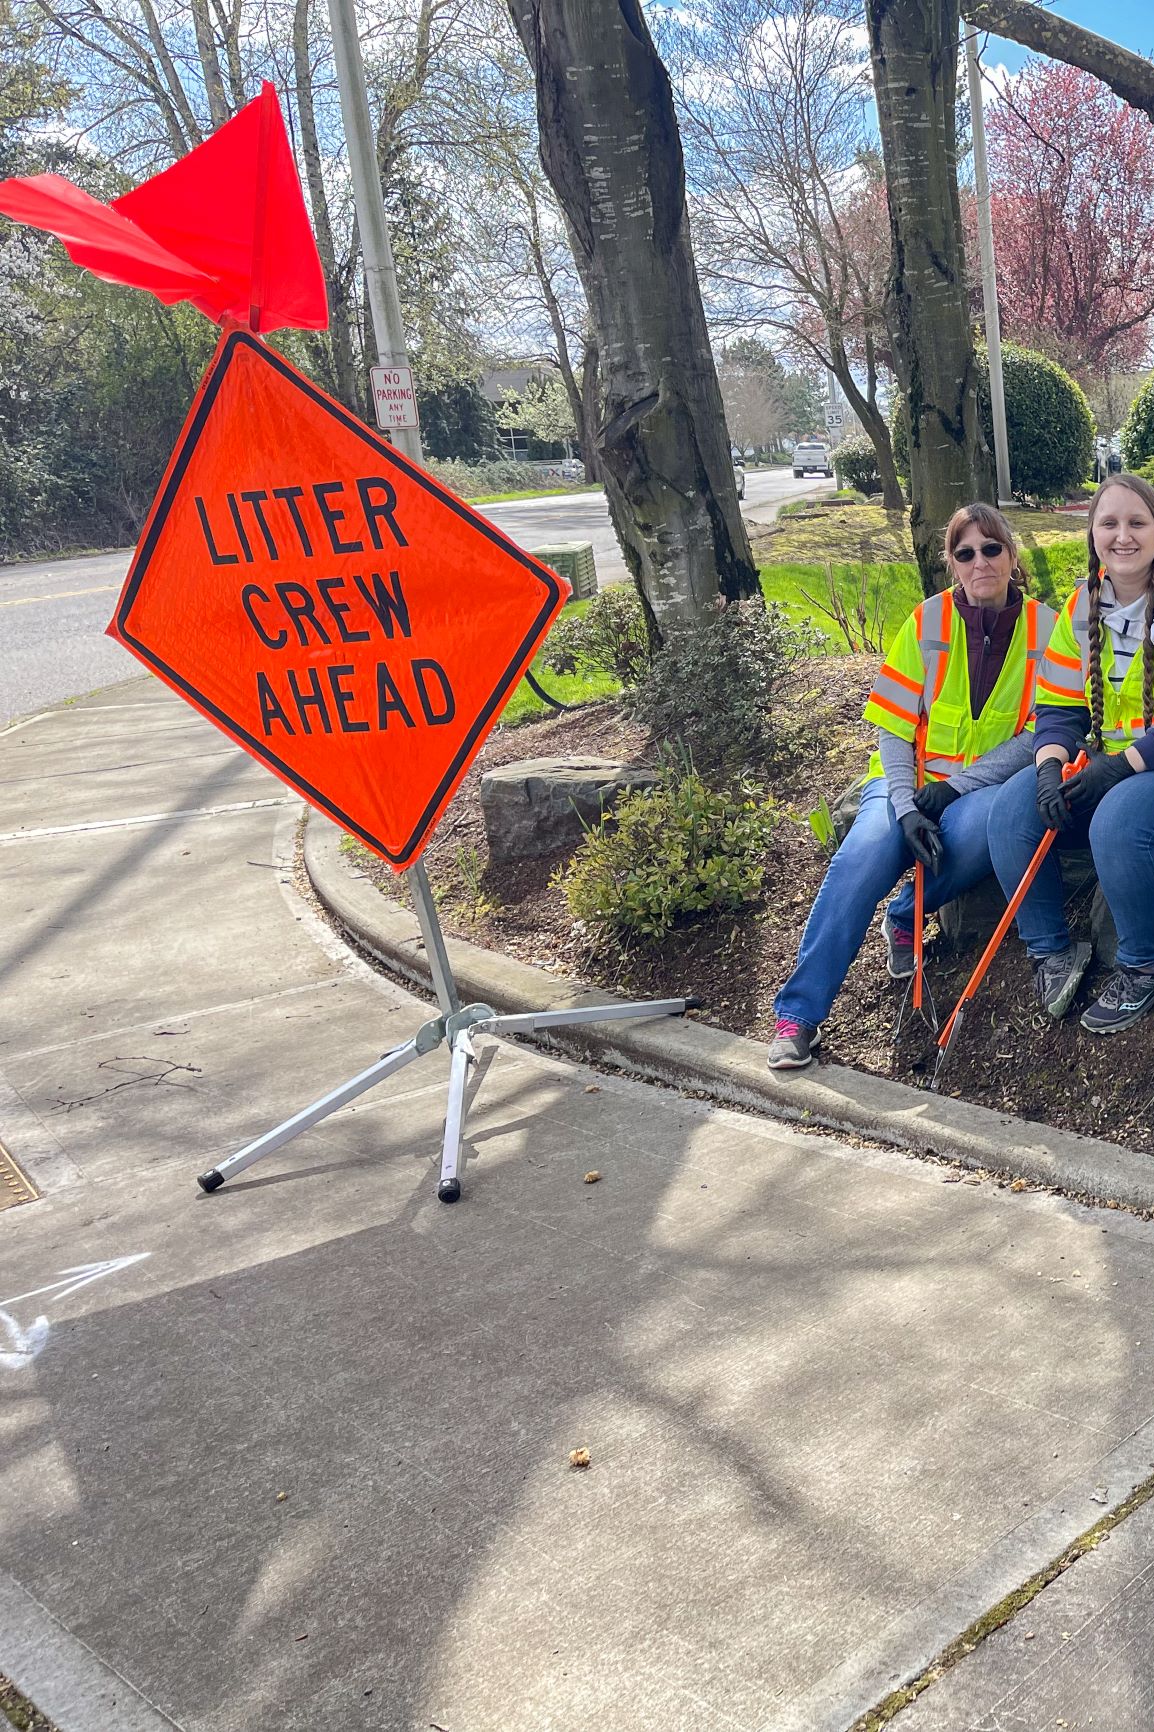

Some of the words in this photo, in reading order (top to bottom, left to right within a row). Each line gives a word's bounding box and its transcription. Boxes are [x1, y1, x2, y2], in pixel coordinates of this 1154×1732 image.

[383, 373, 400, 384] NO
[376, 388, 412, 400] PARKING
[388, 403, 403, 411] ANY
[388, 414, 407, 422] TIME
[827, 415, 842, 424] 35
[194, 476, 409, 565] LITTER
[241, 570, 412, 650] CREW
[256, 658, 456, 736] AHEAD
